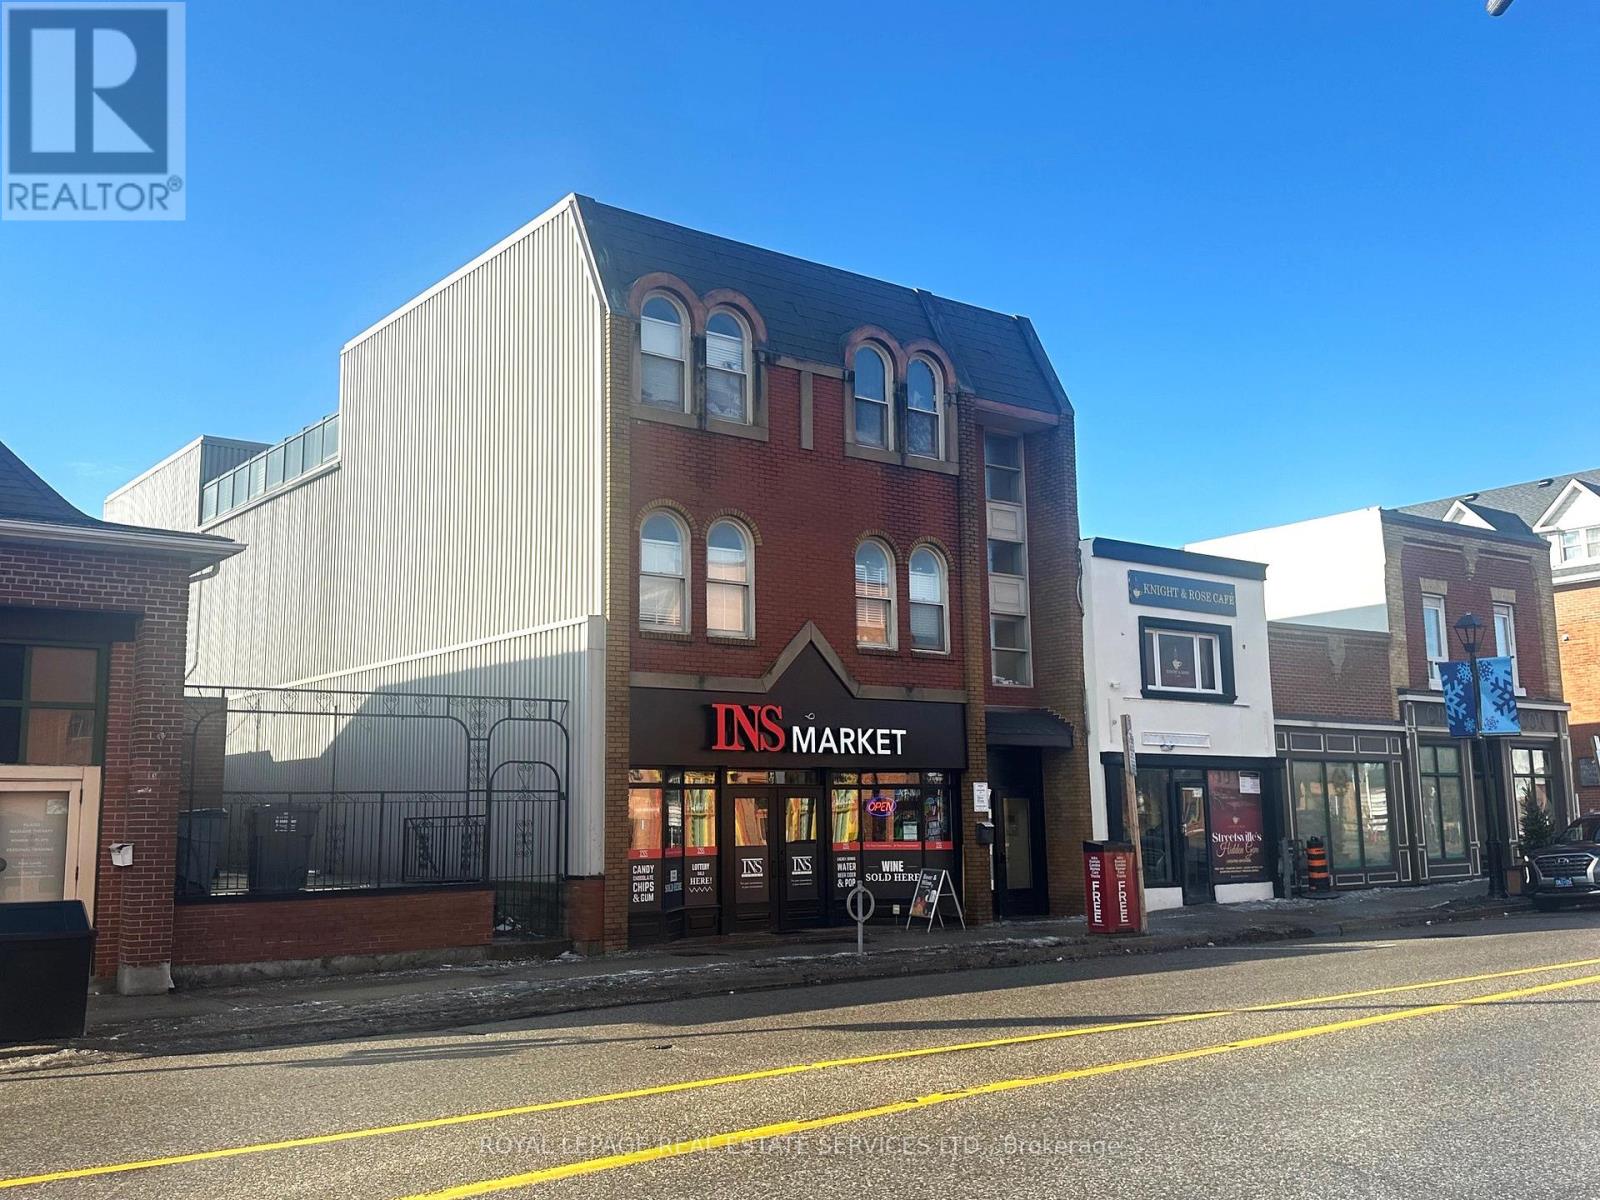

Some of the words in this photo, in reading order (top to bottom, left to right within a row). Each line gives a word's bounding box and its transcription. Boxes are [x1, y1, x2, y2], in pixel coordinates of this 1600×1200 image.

[1143, 583, 1179, 599] KNIGHT
[1180, 588, 1188, 599] &
[1189, 589, 1212, 603] ROSE
[711, 703, 786, 751] INS
[792, 725, 907, 756] MARKET
[867, 801, 894, 813] OPEN
[1211, 831, 1263, 843] Streetsville's
[632, 864, 655, 875] CANDY
[692, 863, 710, 871] LOTTERY
[742, 859, 763, 874] INS
[793, 858, 812, 872] INS
[837, 862, 857, 872] WATER
[881, 860, 904, 873] WINE
[690, 877, 713, 885] HERE!
[837, 879, 844, 888] &
[845, 878, 856, 888] POP
[865, 873, 892, 882] SOLD
[894, 873, 921, 882] HERE
[632, 881, 655, 893] CHIPS
[632, 893, 640, 903] &
[640, 892, 654, 902] GUM
[1092, 880, 1103, 923] FREE
[1118, 880, 1129, 923] FREE
